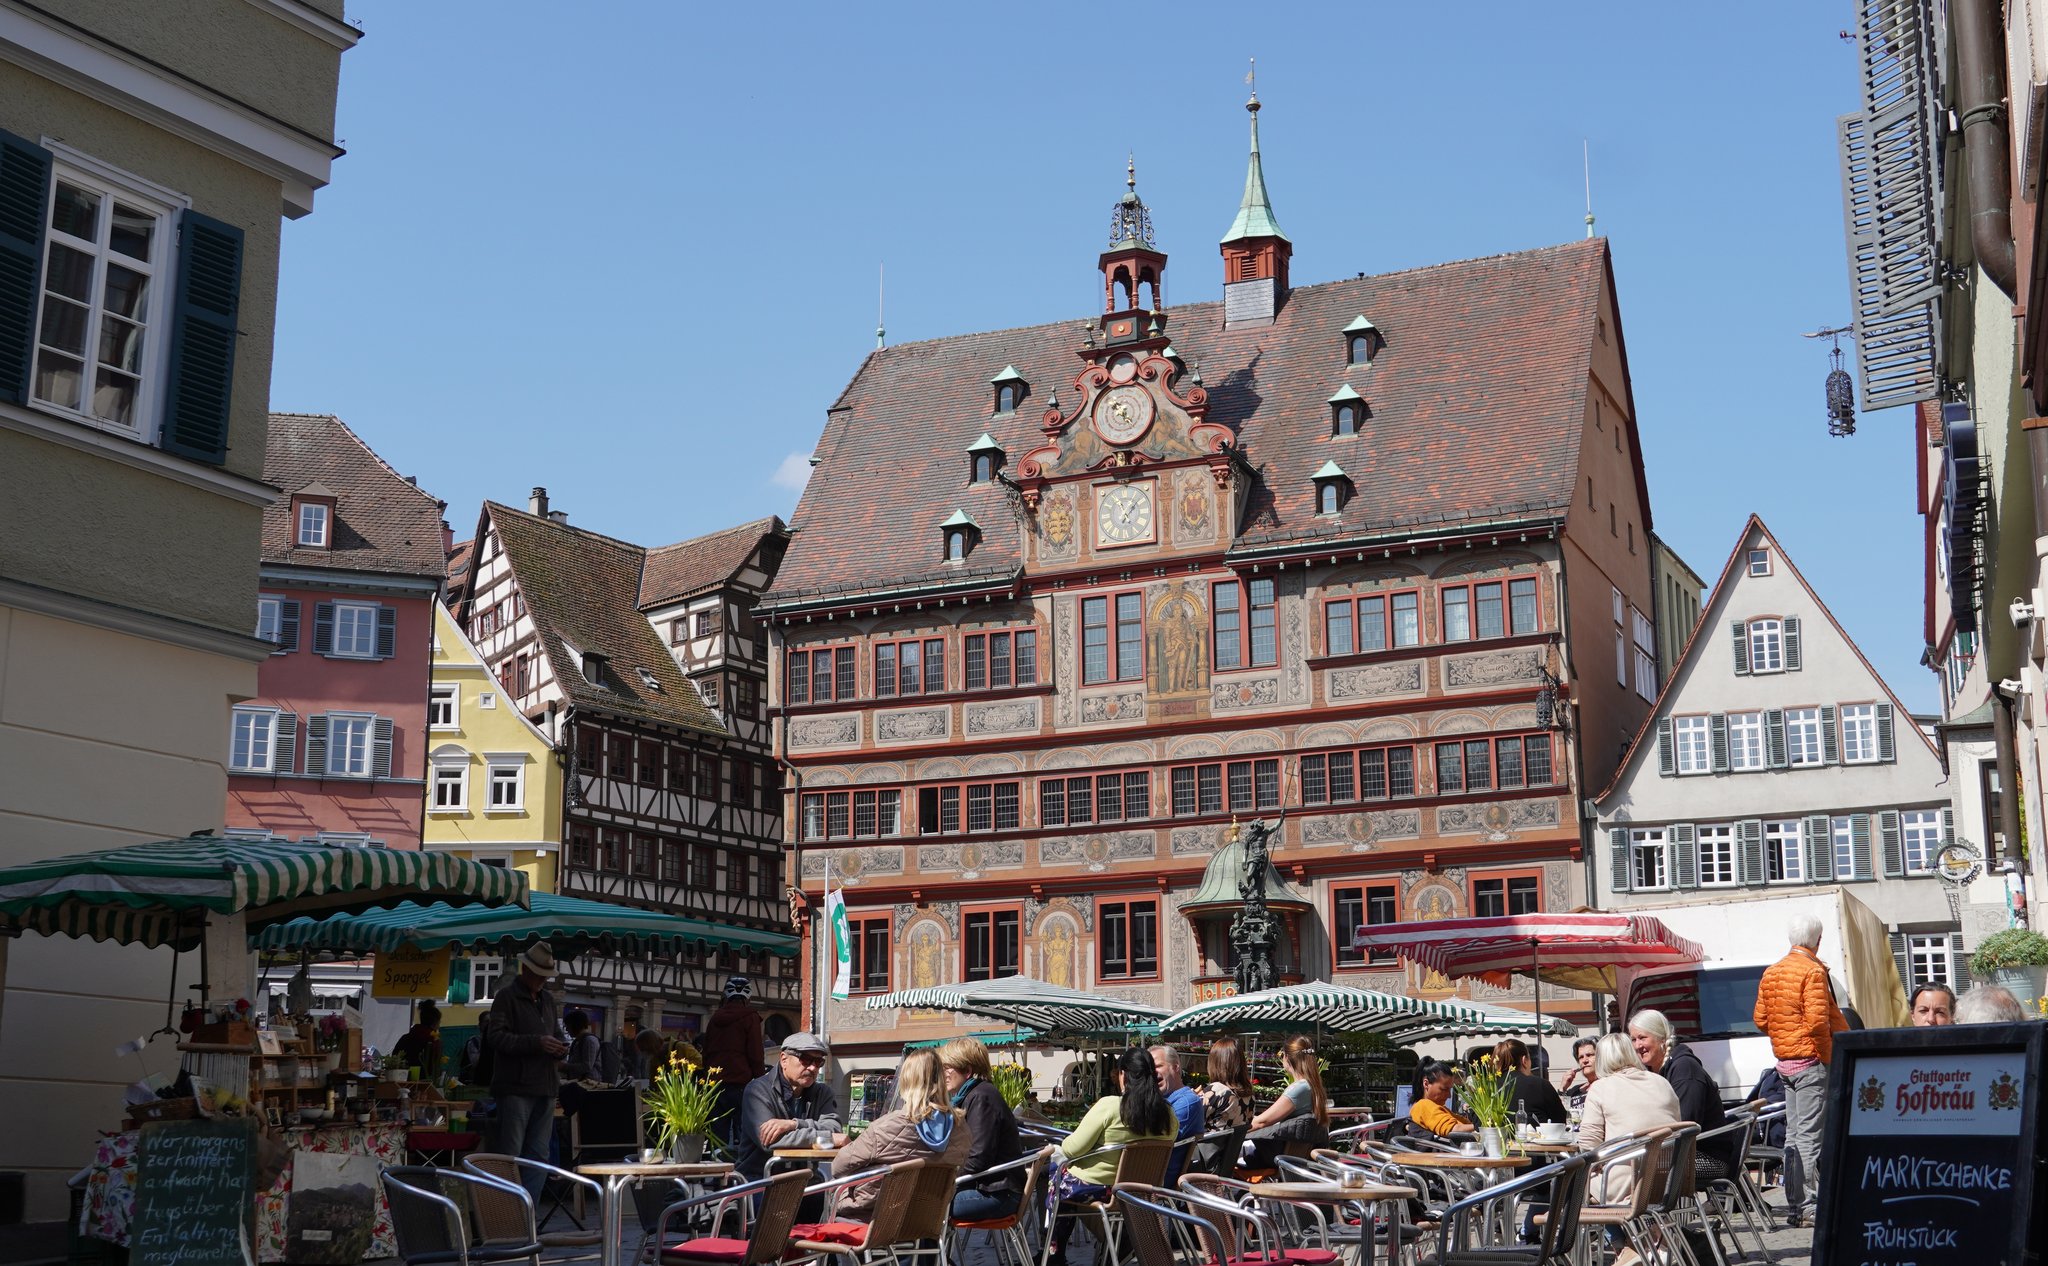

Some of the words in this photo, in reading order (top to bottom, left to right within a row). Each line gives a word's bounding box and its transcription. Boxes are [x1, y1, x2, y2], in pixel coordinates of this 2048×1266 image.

[384, 967, 432, 993] Spargel
[1910, 1069, 1971, 1086] Stuttgarter
[1896, 1083, 1975, 1116] Hofbräu
[147, 1129, 183, 1150] Wer
[184, 1135, 246, 1156] morgens
[1861, 1155, 2012, 1190] MARKTSCHENKE
[1863, 1218, 1959, 1250] FRÜHSTÜCK
